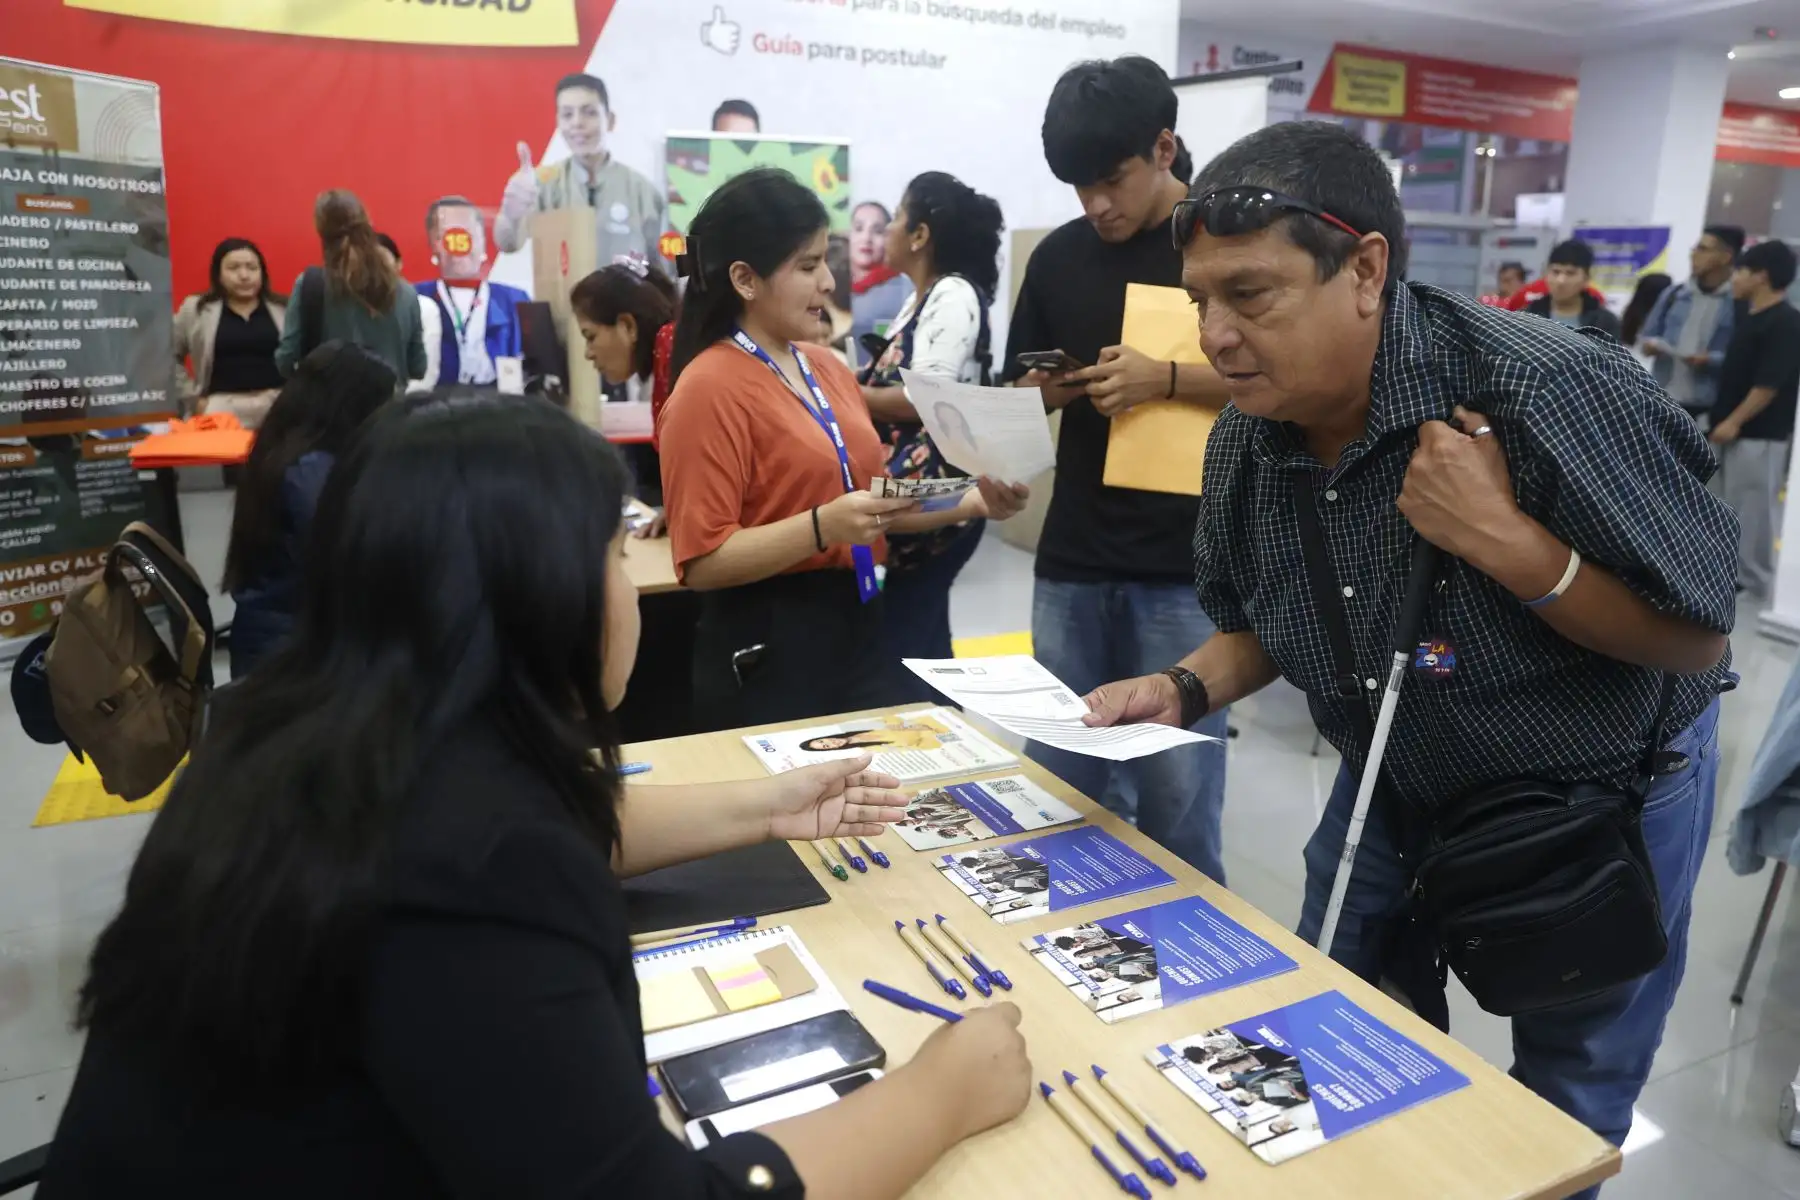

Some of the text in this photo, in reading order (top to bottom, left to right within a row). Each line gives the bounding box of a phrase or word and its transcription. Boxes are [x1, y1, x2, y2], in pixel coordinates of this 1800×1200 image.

[1027, 9, 1057, 30] del
[1060, 16, 1127, 40] empleo
[752, 32, 946, 69] Guía para postular
[0, 168, 34, 182] AJA
[38, 171, 69, 186] CON
[0, 216, 50, 229] ADERO
[64, 218, 139, 234] PASTELERO
[446, 233, 470, 252] 15
[57, 259, 75, 271] DE
[77, 259, 125, 272] COCINA
[60, 280, 78, 291] DE
[62, 319, 82, 331] DE
[63, 377, 81, 388] DE
[0, 565, 46, 582] VIAR
[51, 557, 70, 574] CV
[75, 554, 96, 568] AL
